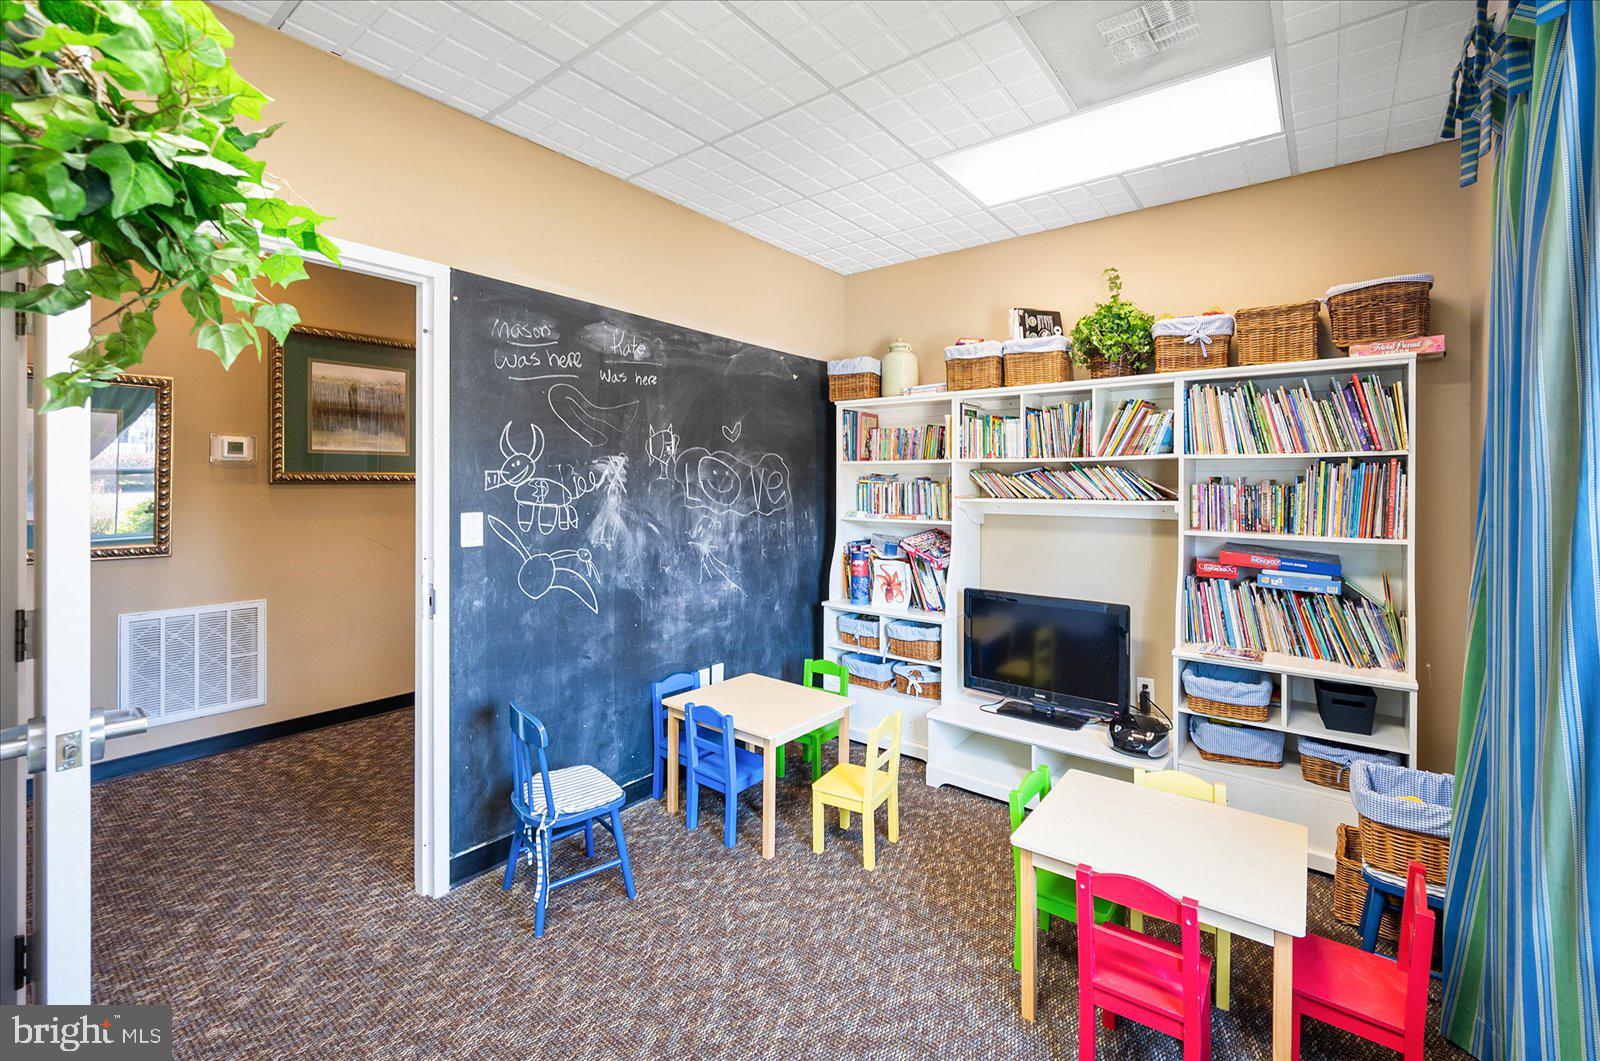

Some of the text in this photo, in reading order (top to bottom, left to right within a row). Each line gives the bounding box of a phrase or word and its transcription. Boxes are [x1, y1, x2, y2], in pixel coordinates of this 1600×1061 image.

[610, 332, 646, 358] Kate
[545, 349, 583, 369] here
[635, 372, 658, 386] here
